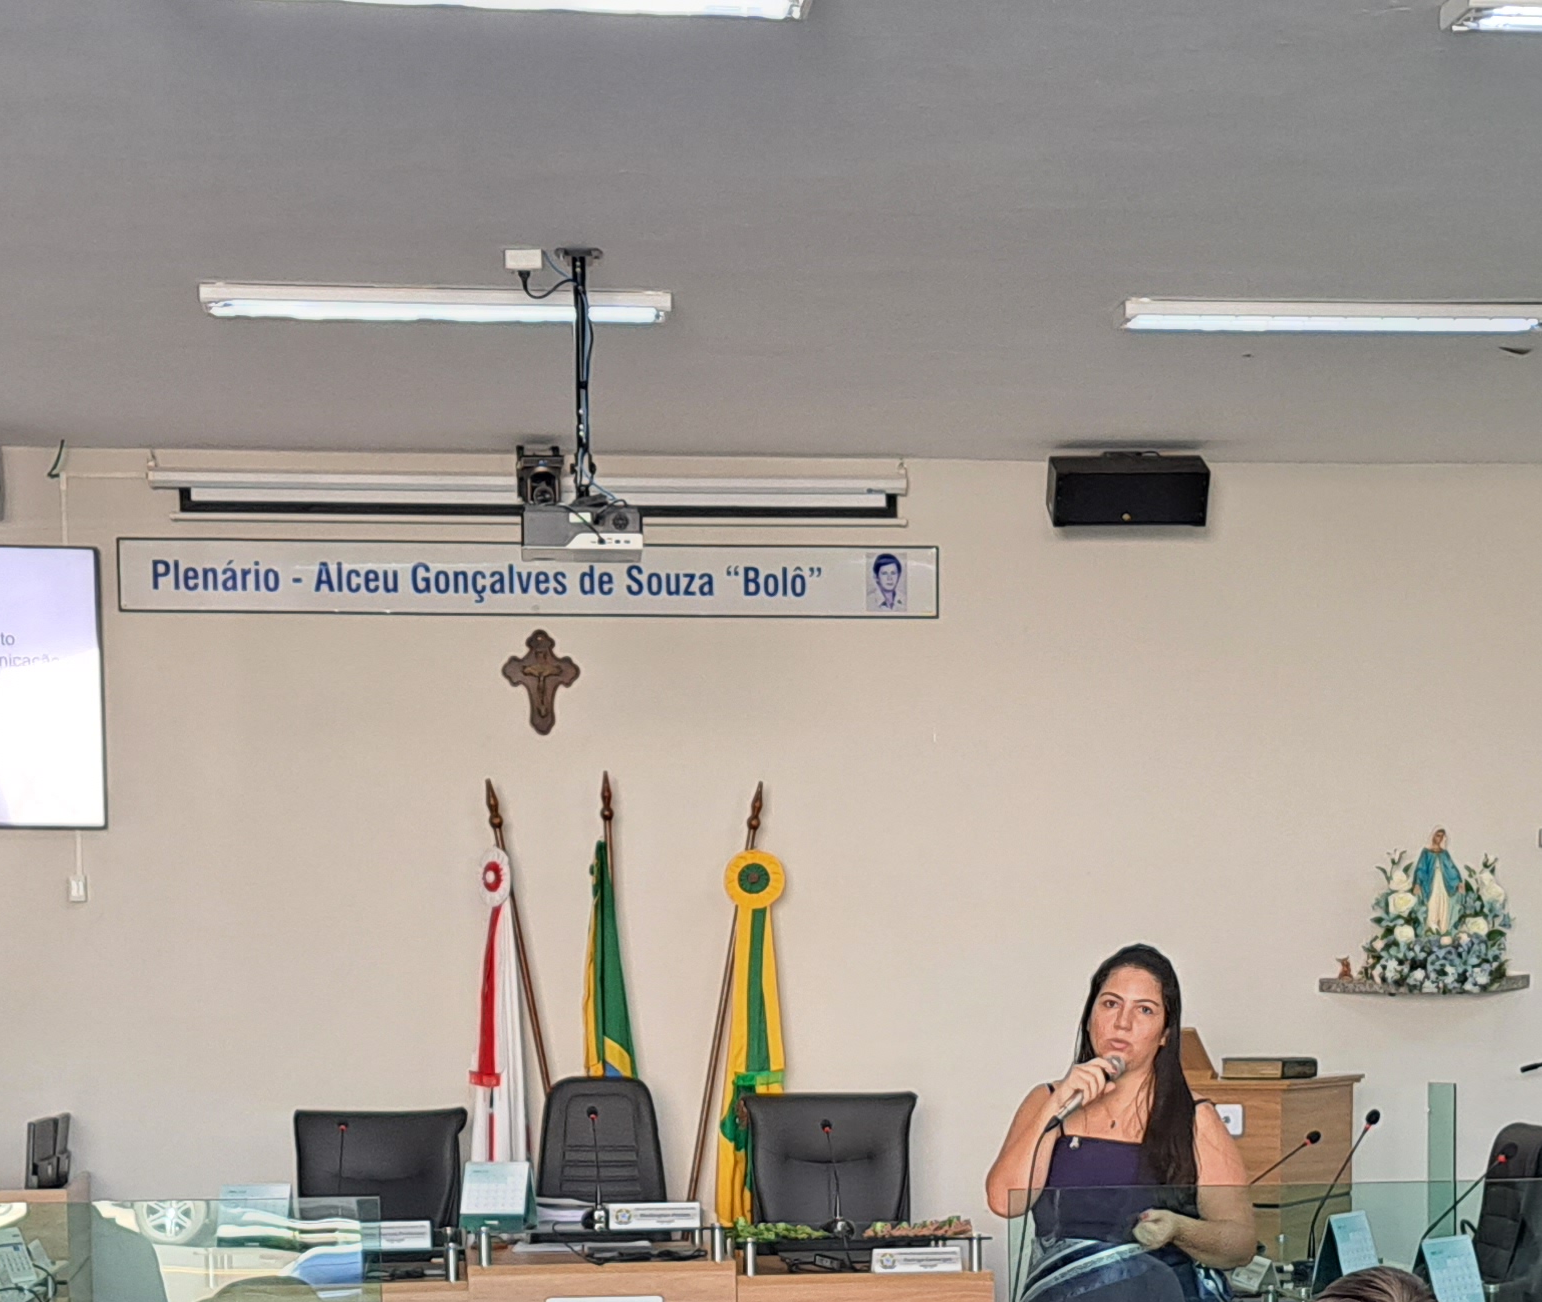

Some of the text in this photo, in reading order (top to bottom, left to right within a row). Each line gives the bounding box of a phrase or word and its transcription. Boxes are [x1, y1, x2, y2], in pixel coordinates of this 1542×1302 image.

[151, 559, 823, 604] Plenário - Alceu Gonçalves de Souza “Bolô”
